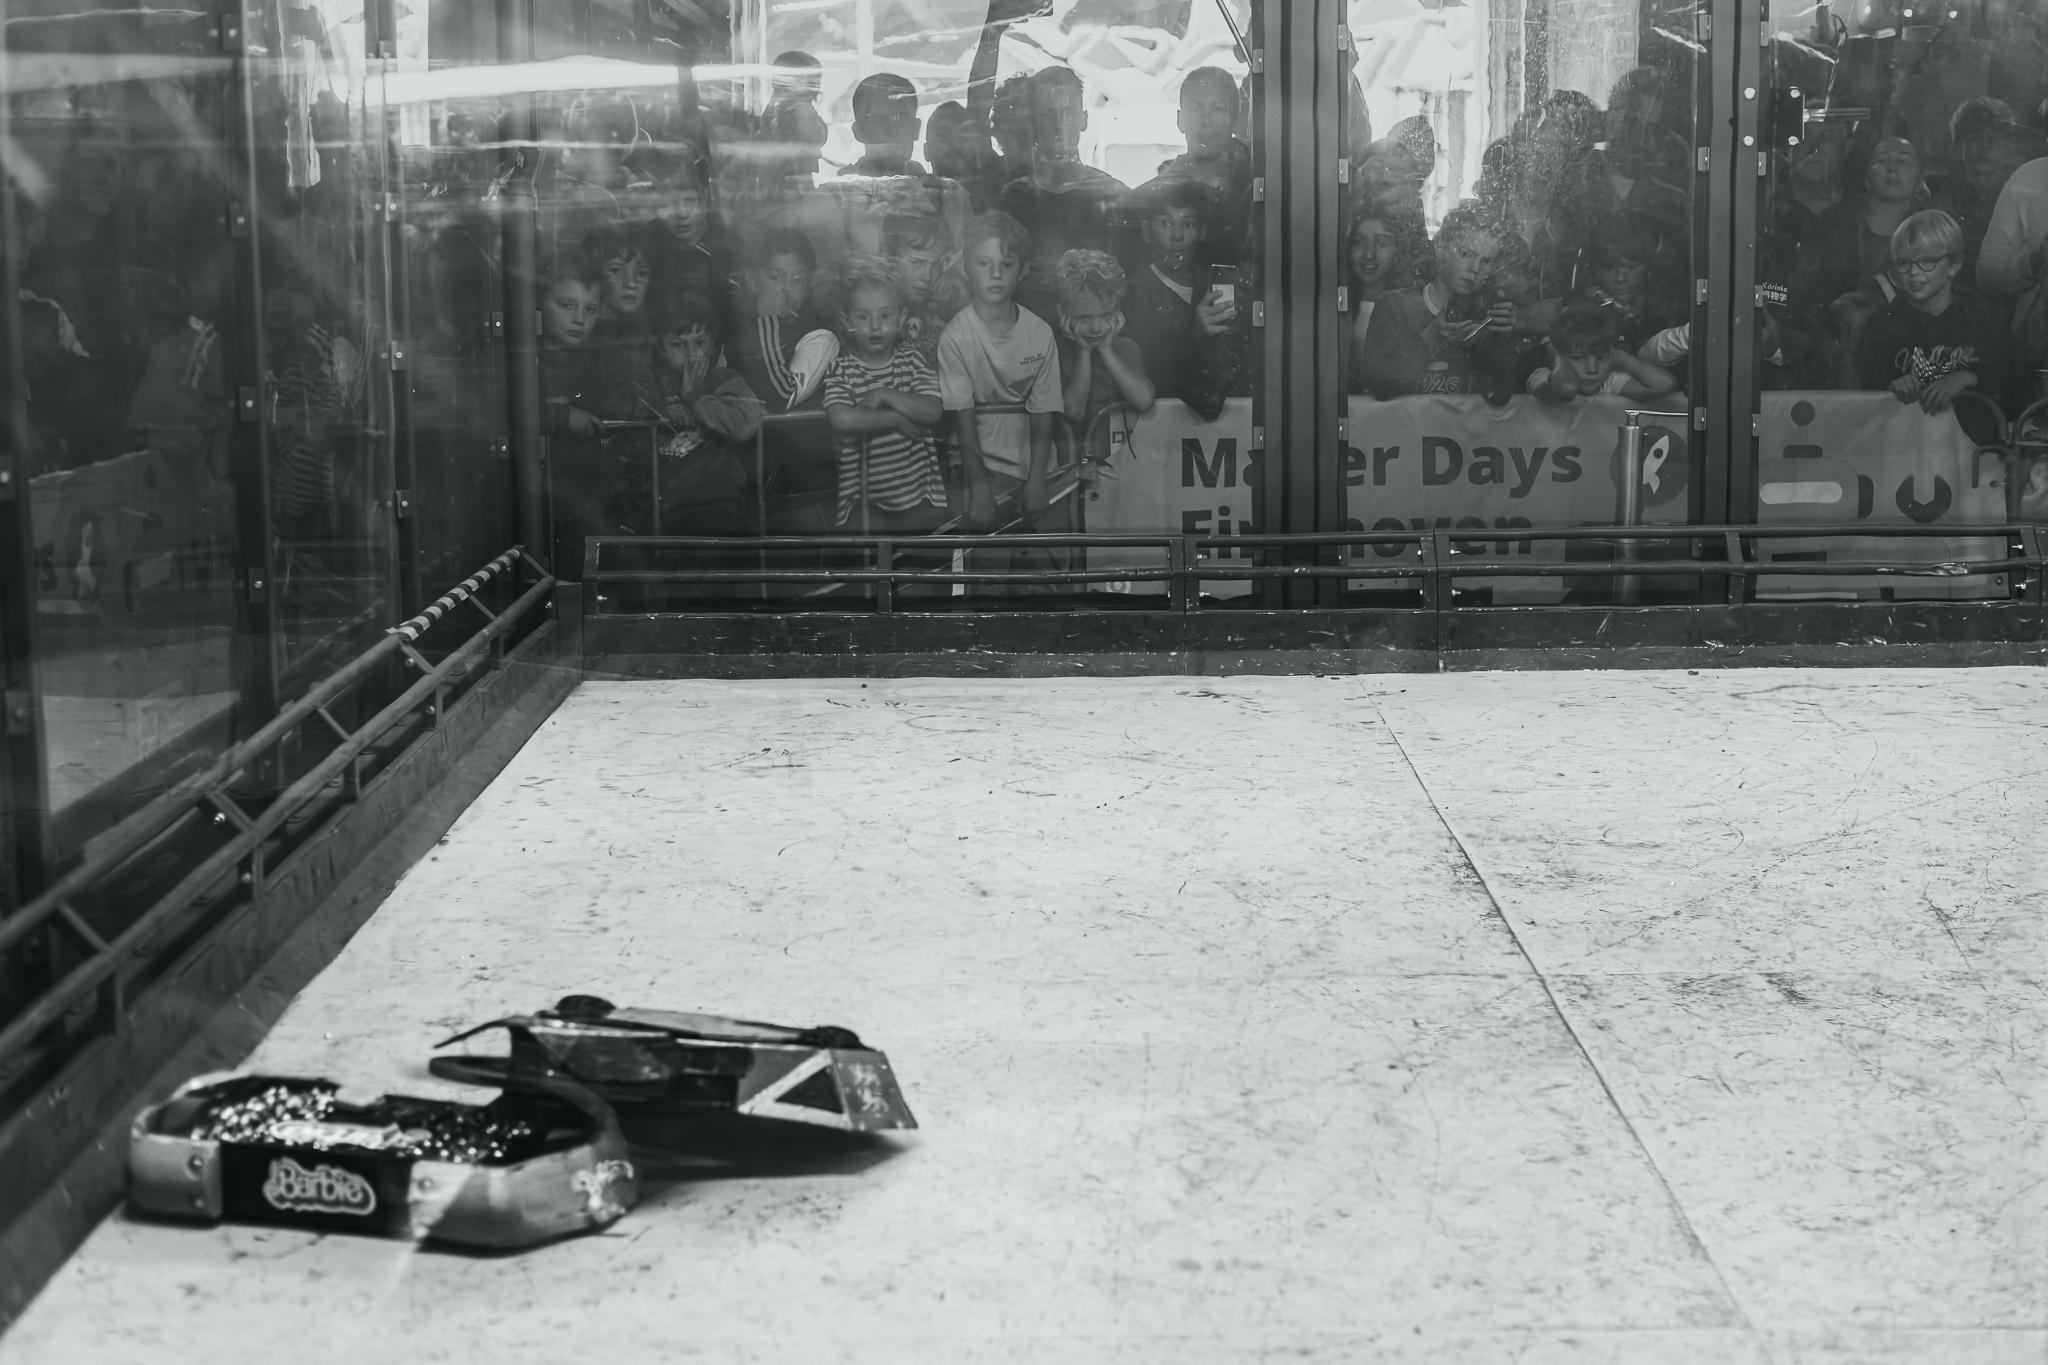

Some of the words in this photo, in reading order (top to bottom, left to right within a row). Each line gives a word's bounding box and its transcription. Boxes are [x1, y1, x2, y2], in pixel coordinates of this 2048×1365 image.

[1181, 437, 1400, 489] Mer
[1421, 435, 1582, 499] Days
[268, 1159, 371, 1210] Barbie
